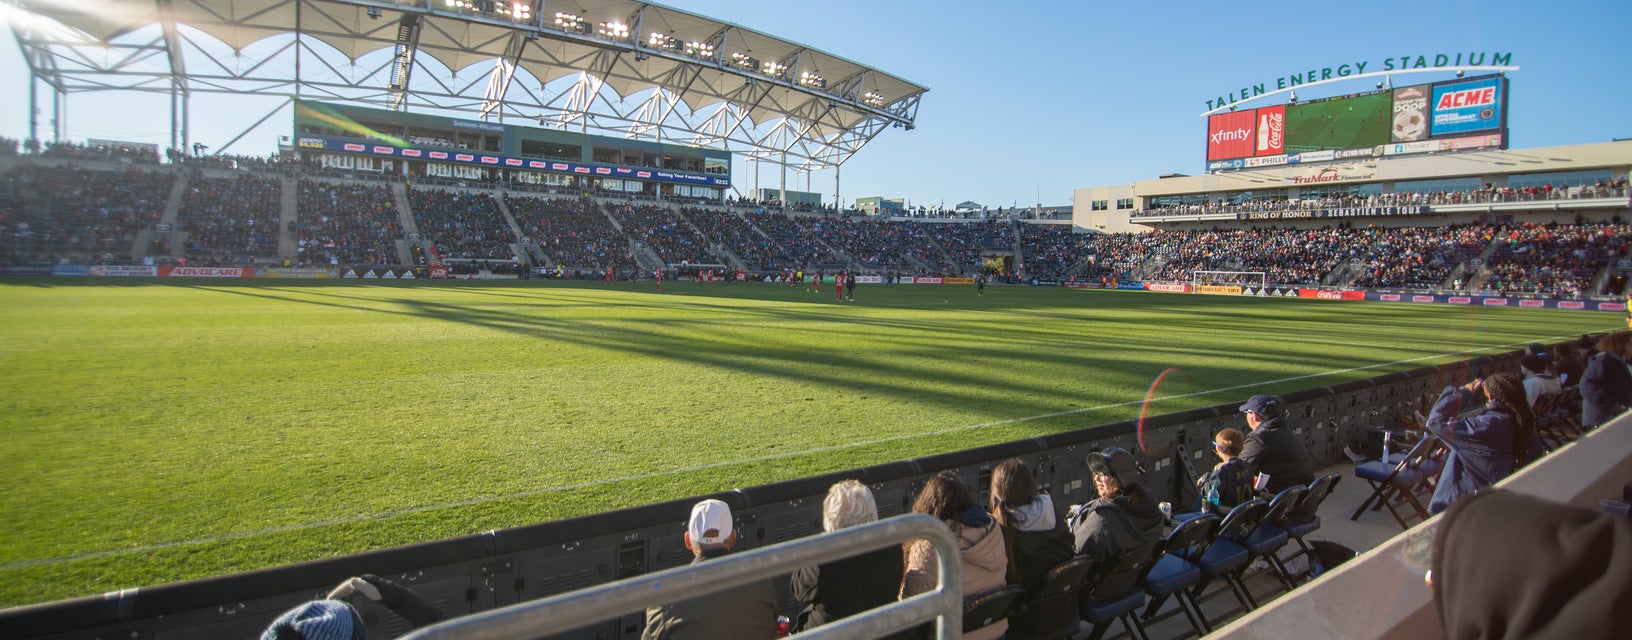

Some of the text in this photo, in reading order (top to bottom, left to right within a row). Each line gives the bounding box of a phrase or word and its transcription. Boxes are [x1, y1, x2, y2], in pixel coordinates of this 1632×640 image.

[1206, 52, 1513, 111] TALEN ENERGY STADIUM
[1436, 86, 1496, 111] ACME
[1394, 102, 1426, 112] DOOP
[1210, 128, 1251, 144] xfinity
[1262, 156, 1287, 164] PHILLY
[1294, 172, 1372, 184] TruMark Financial
[1328, 208, 1376, 217] SEBASTIEN
[1396, 206, 1420, 214] TOUX
[173, 268, 241, 276] ADVOCARE
